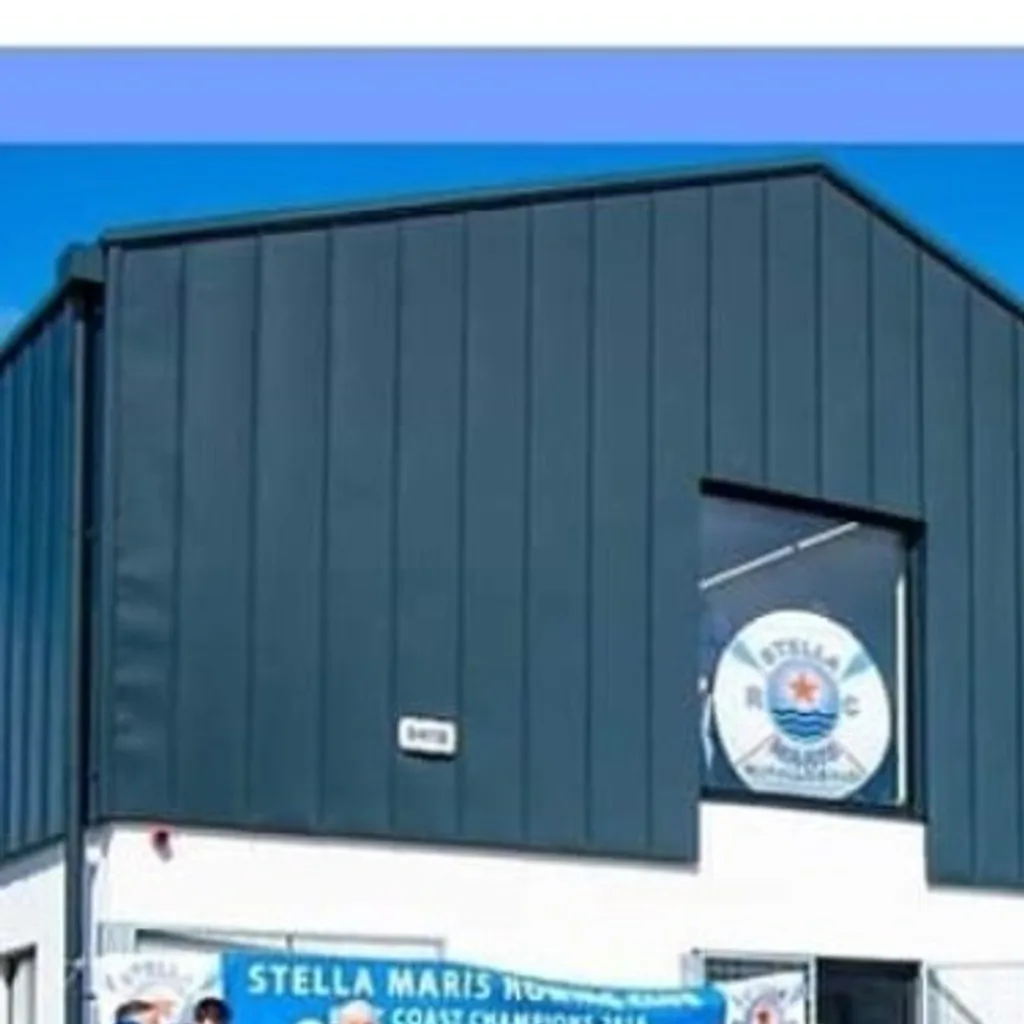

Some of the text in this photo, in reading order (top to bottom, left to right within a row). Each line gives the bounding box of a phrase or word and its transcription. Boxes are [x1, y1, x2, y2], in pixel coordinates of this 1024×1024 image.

[761, 638, 840, 670] STELLA
[248, 964, 374, 998] STELLA
[386, 967, 493, 1001] MARIS
